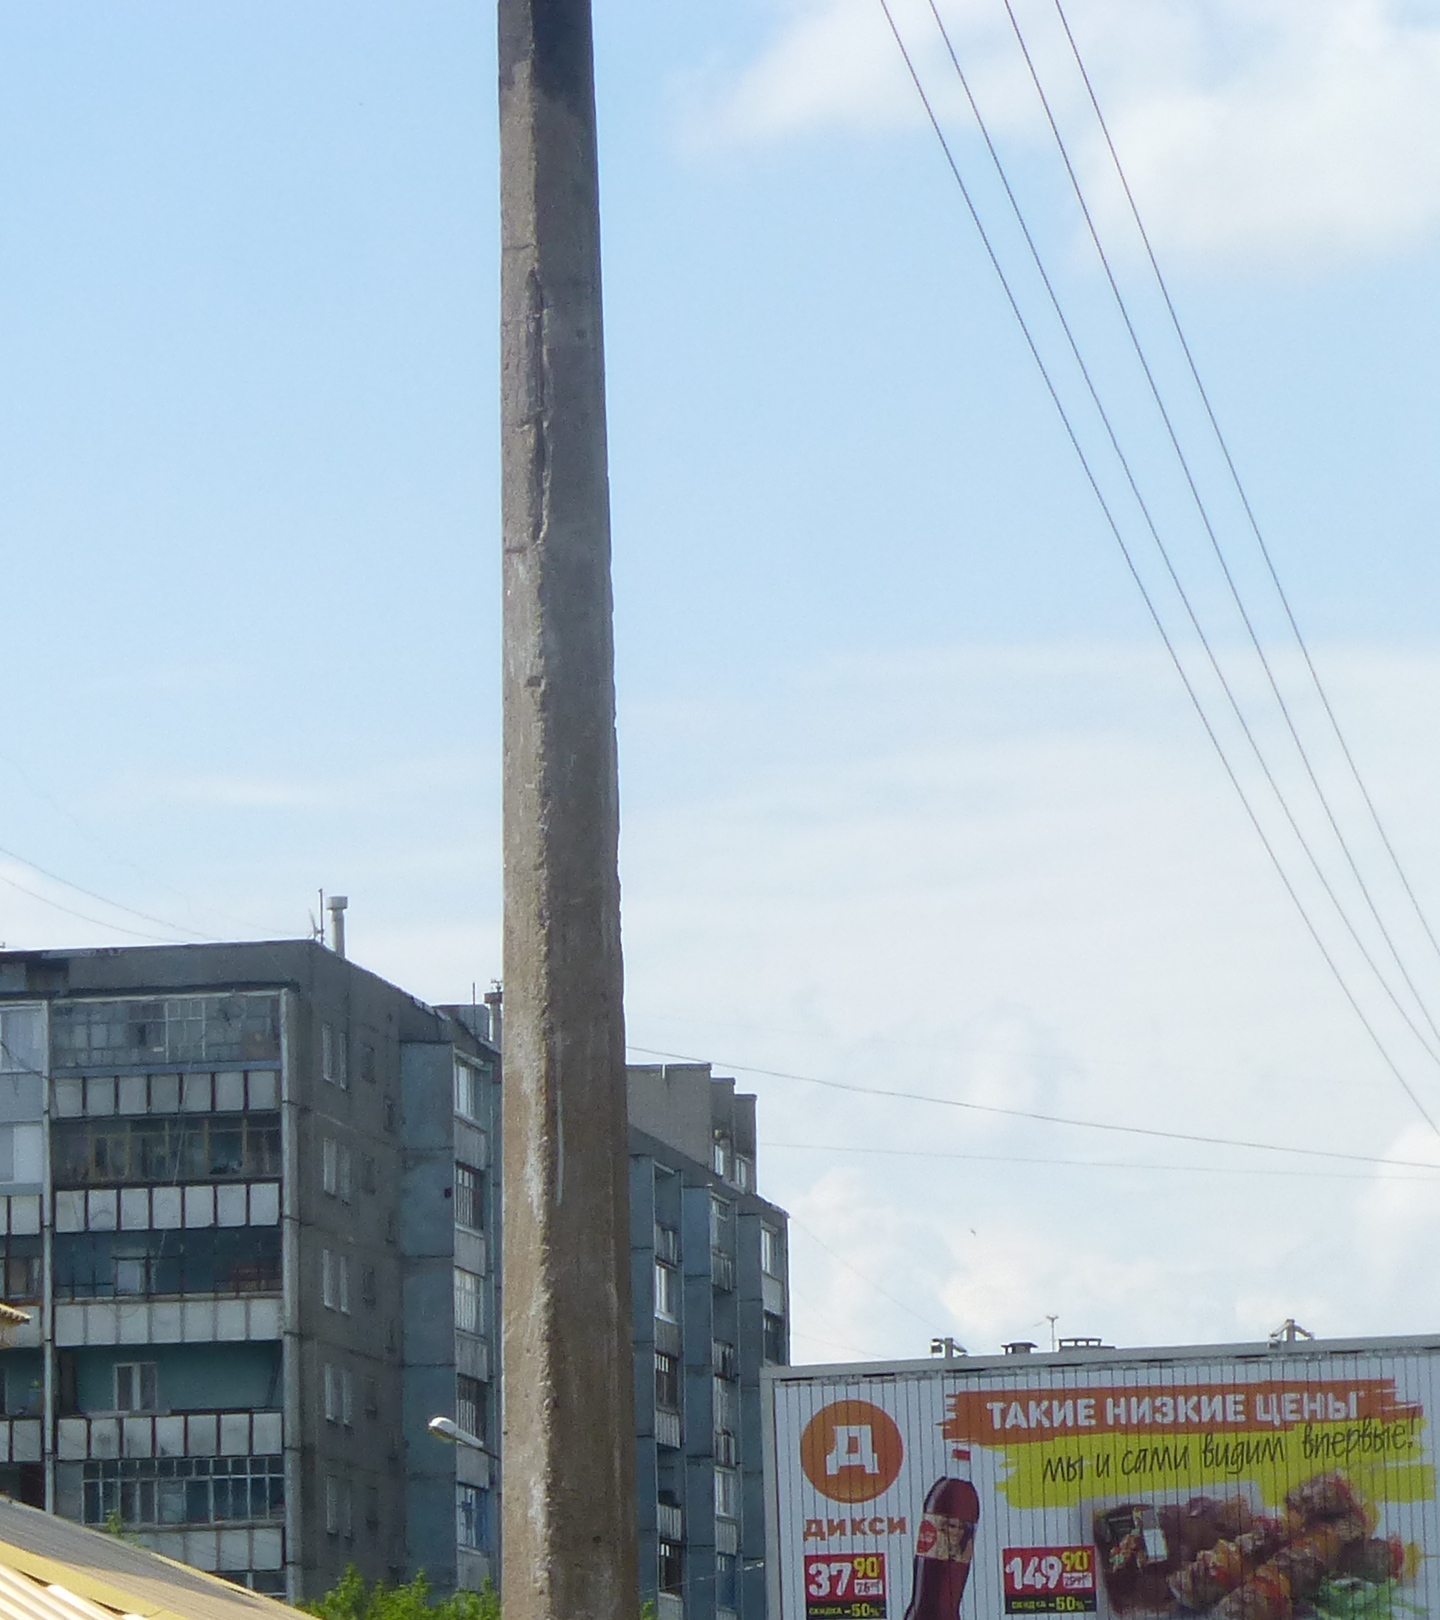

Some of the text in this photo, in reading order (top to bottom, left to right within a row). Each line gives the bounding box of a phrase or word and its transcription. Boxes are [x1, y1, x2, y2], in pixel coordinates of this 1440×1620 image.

[986, 1398, 1096, 1431] ТАКИЕ
[1105, 1394, 1247, 1426] НИЗКИЕ
[825, 1424, 880, 1475] Д
[1042, 1411, 1419, 1483] мы и сами видим впервые!
[803, 1516, 908, 1542] ДИКСИ
[808, 1562, 852, 1597] 37
[1005, 1555, 1063, 1590] 149
